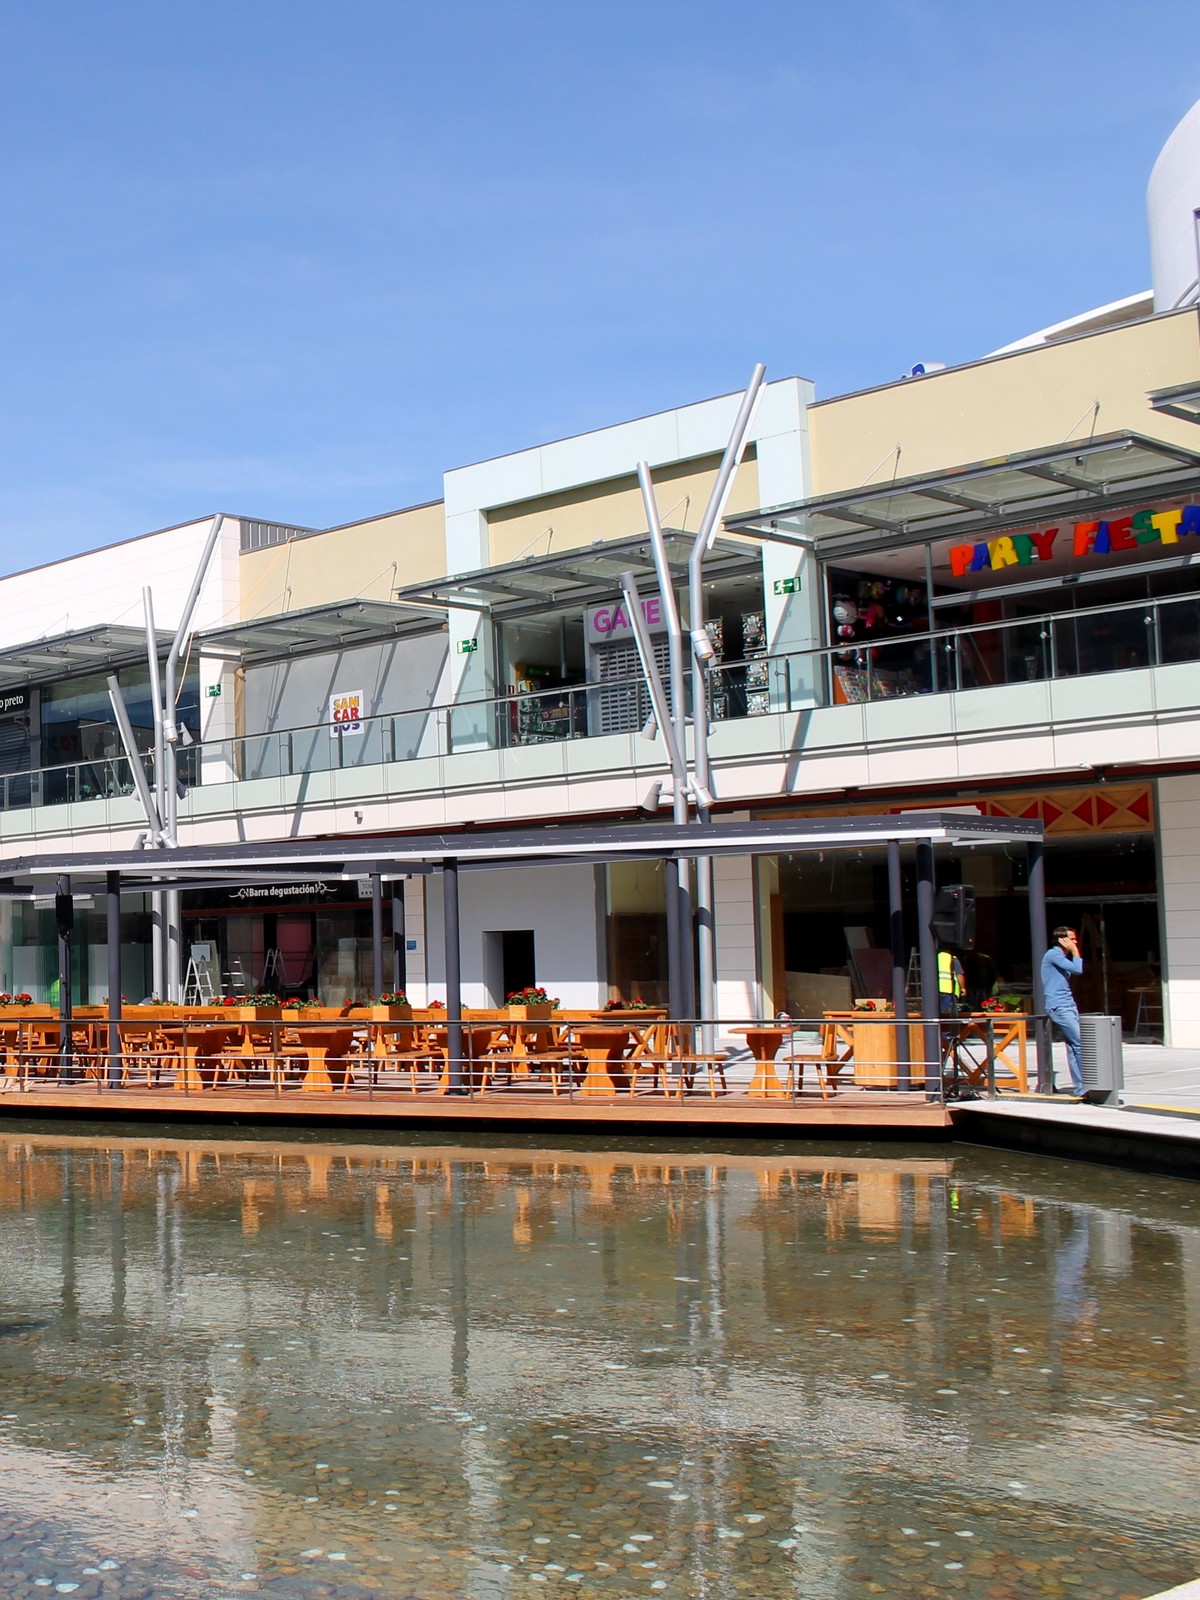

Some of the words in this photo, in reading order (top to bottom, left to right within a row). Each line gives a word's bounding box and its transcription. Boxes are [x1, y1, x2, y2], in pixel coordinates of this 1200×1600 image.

[949, 528, 1059, 577] PARTY
[1073, 505, 1200, 556] FIESTA
[593, 598, 660, 633] GAE
[5, 695, 24, 711] preto
[333, 696, 360, 710] SAN
[333, 707, 360, 722] CAR
[249, 888, 269, 897] Barra
[269, 884, 315, 897] degustación
